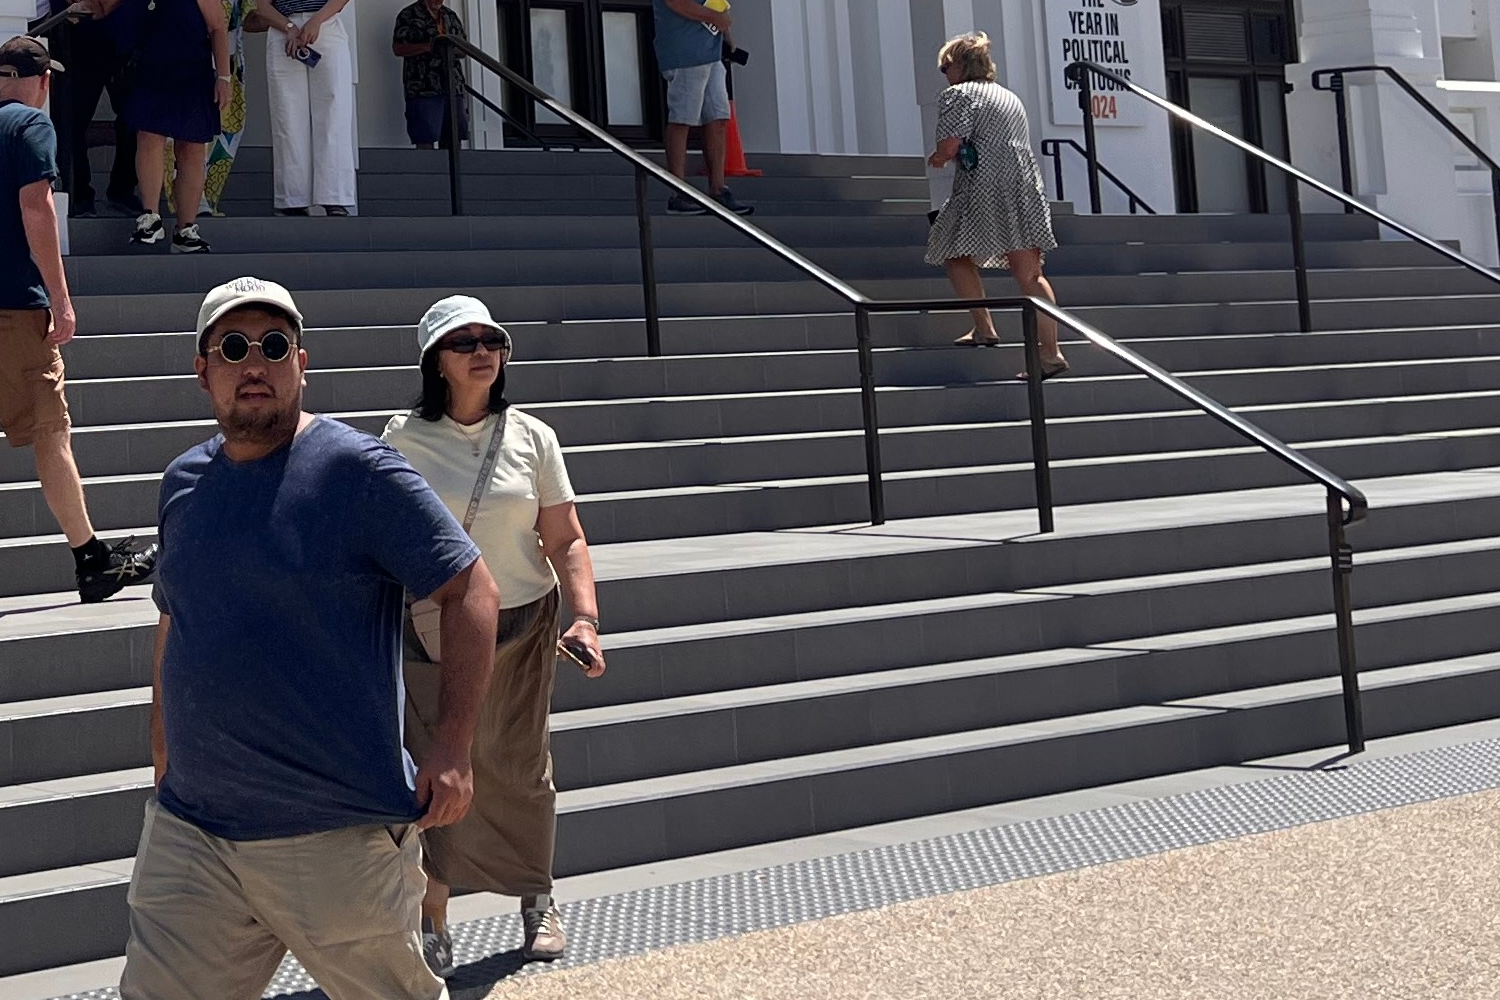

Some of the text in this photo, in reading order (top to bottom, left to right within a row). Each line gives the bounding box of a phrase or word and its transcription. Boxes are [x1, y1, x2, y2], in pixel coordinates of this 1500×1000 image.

[1068, 10, 1120, 36] YEAR IN
[1062, 38, 1130, 64] POLITICAL
[1090, 95, 1117, 119] 024
